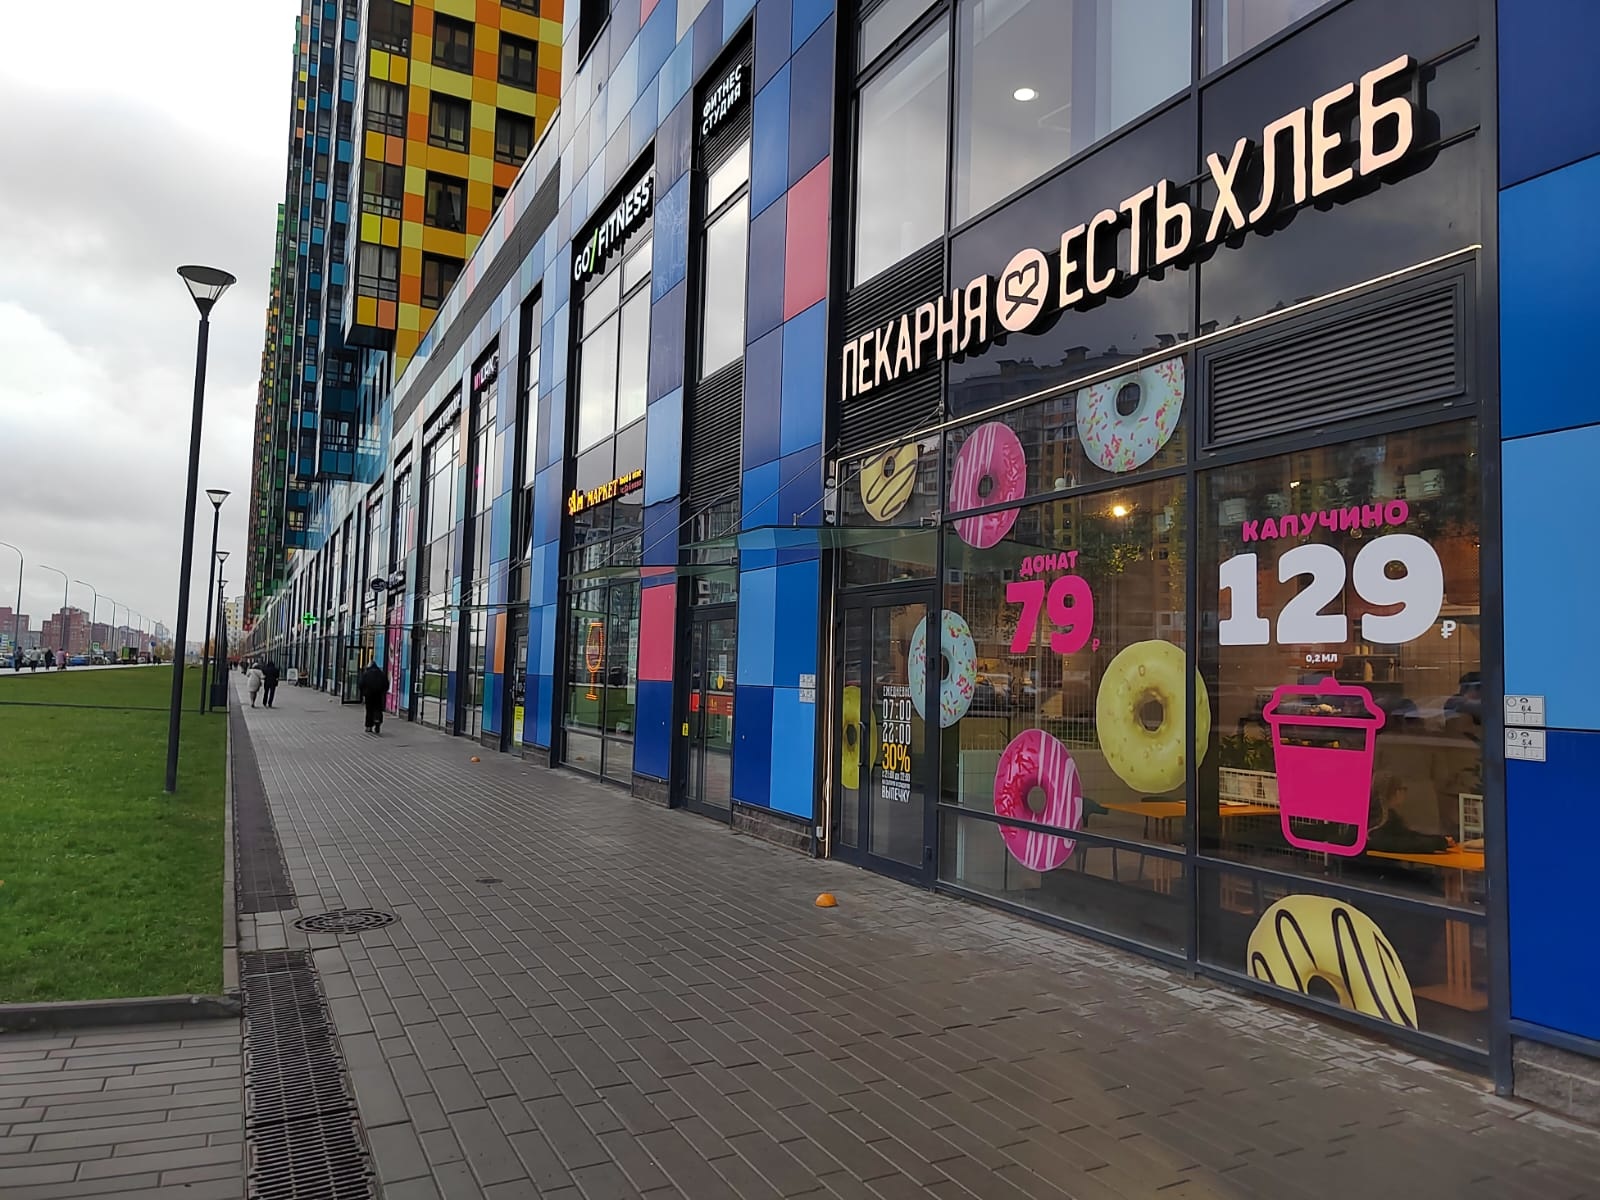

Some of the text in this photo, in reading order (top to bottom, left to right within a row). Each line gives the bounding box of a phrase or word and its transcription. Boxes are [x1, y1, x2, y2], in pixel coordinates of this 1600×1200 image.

[702, 82, 741, 135] СТУДИЯ
[703, 64, 742, 117] ФИТНЕС
[842, 54, 1414, 402] ПЕКАРНЯ ЕСТЬ ХЛЕБ
[586, 479, 618, 508] МАРКЕТ
[1242, 500, 1409, 543] КАПУЧИНО
[1020, 550, 1078, 577] ДОНАТ
[1219, 534, 1444, 646] 129
[1006, 575, 1094, 654] 79
[883, 698, 912, 720] 07:00
[882, 722, 911, 745] 22:00
[882, 743, 911, 773] 30%
[881, 785, 911, 803] ВЫПЕЧКУ
